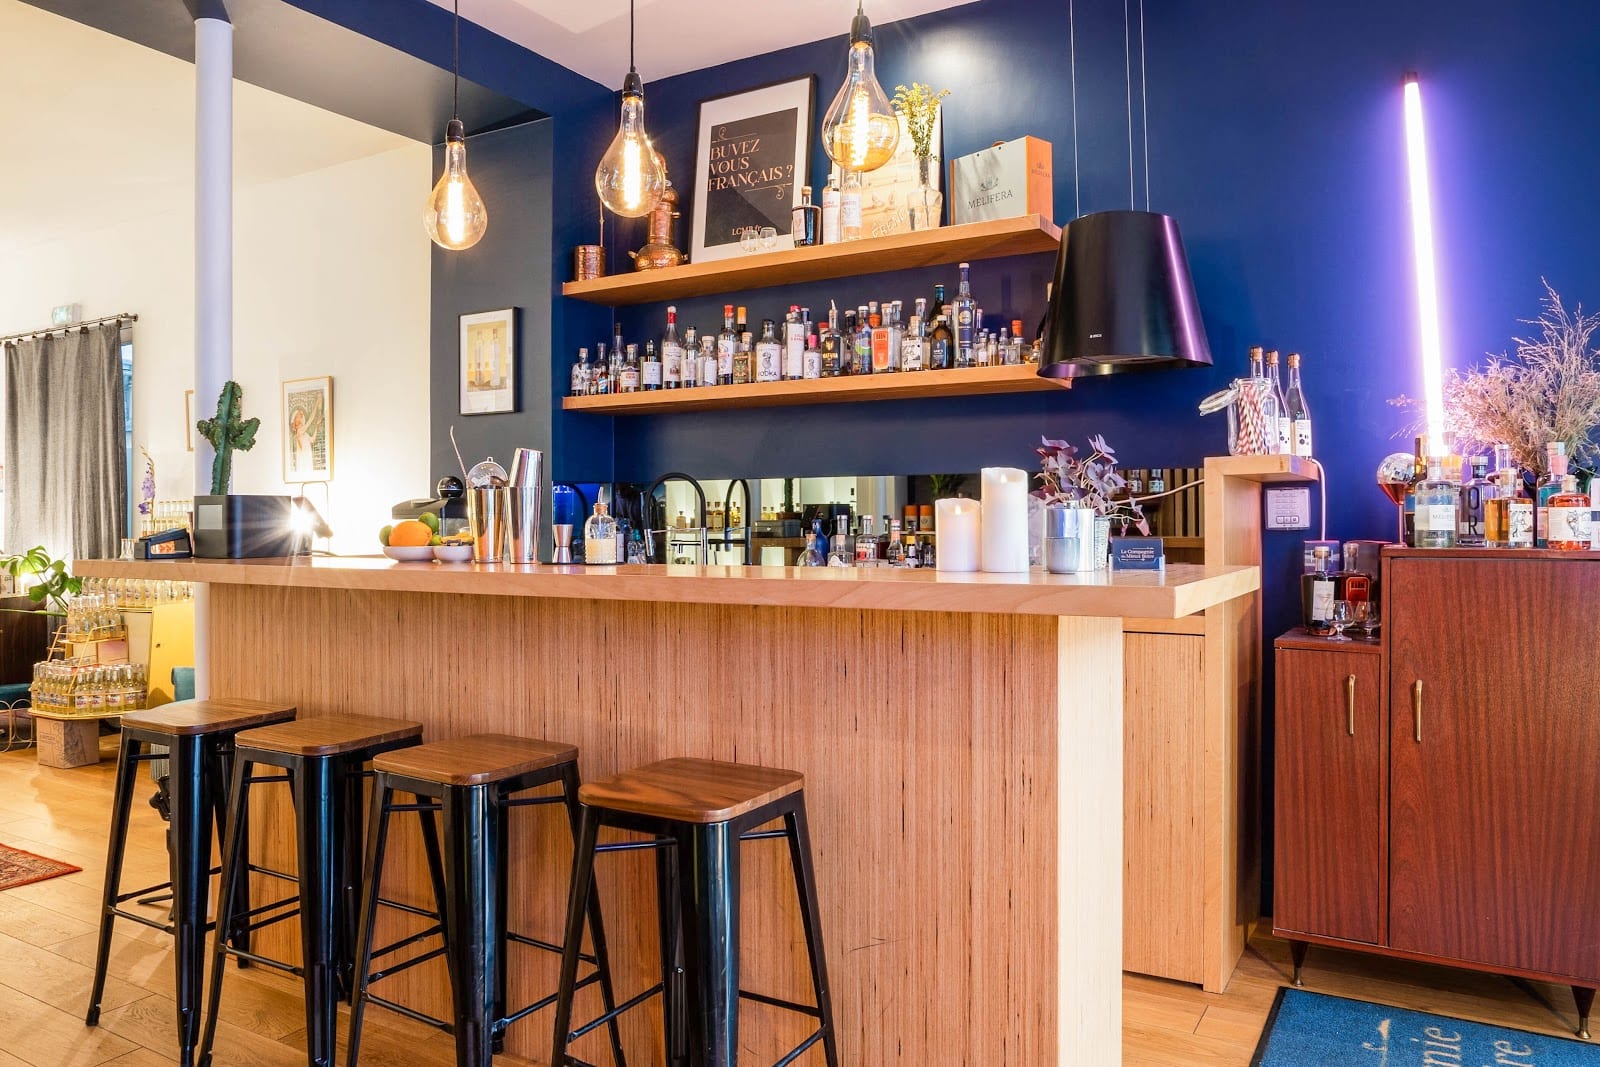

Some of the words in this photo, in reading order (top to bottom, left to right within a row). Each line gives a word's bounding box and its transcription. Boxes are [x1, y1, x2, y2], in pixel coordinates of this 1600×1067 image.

[710, 138, 760, 160] BUVEZ
[710, 156, 750, 175] VOUS
[707, 166, 783, 192] FRANÇAIS
[1410, 1027, 1462, 1067] nie
[1482, 1040, 1533, 1067] re
